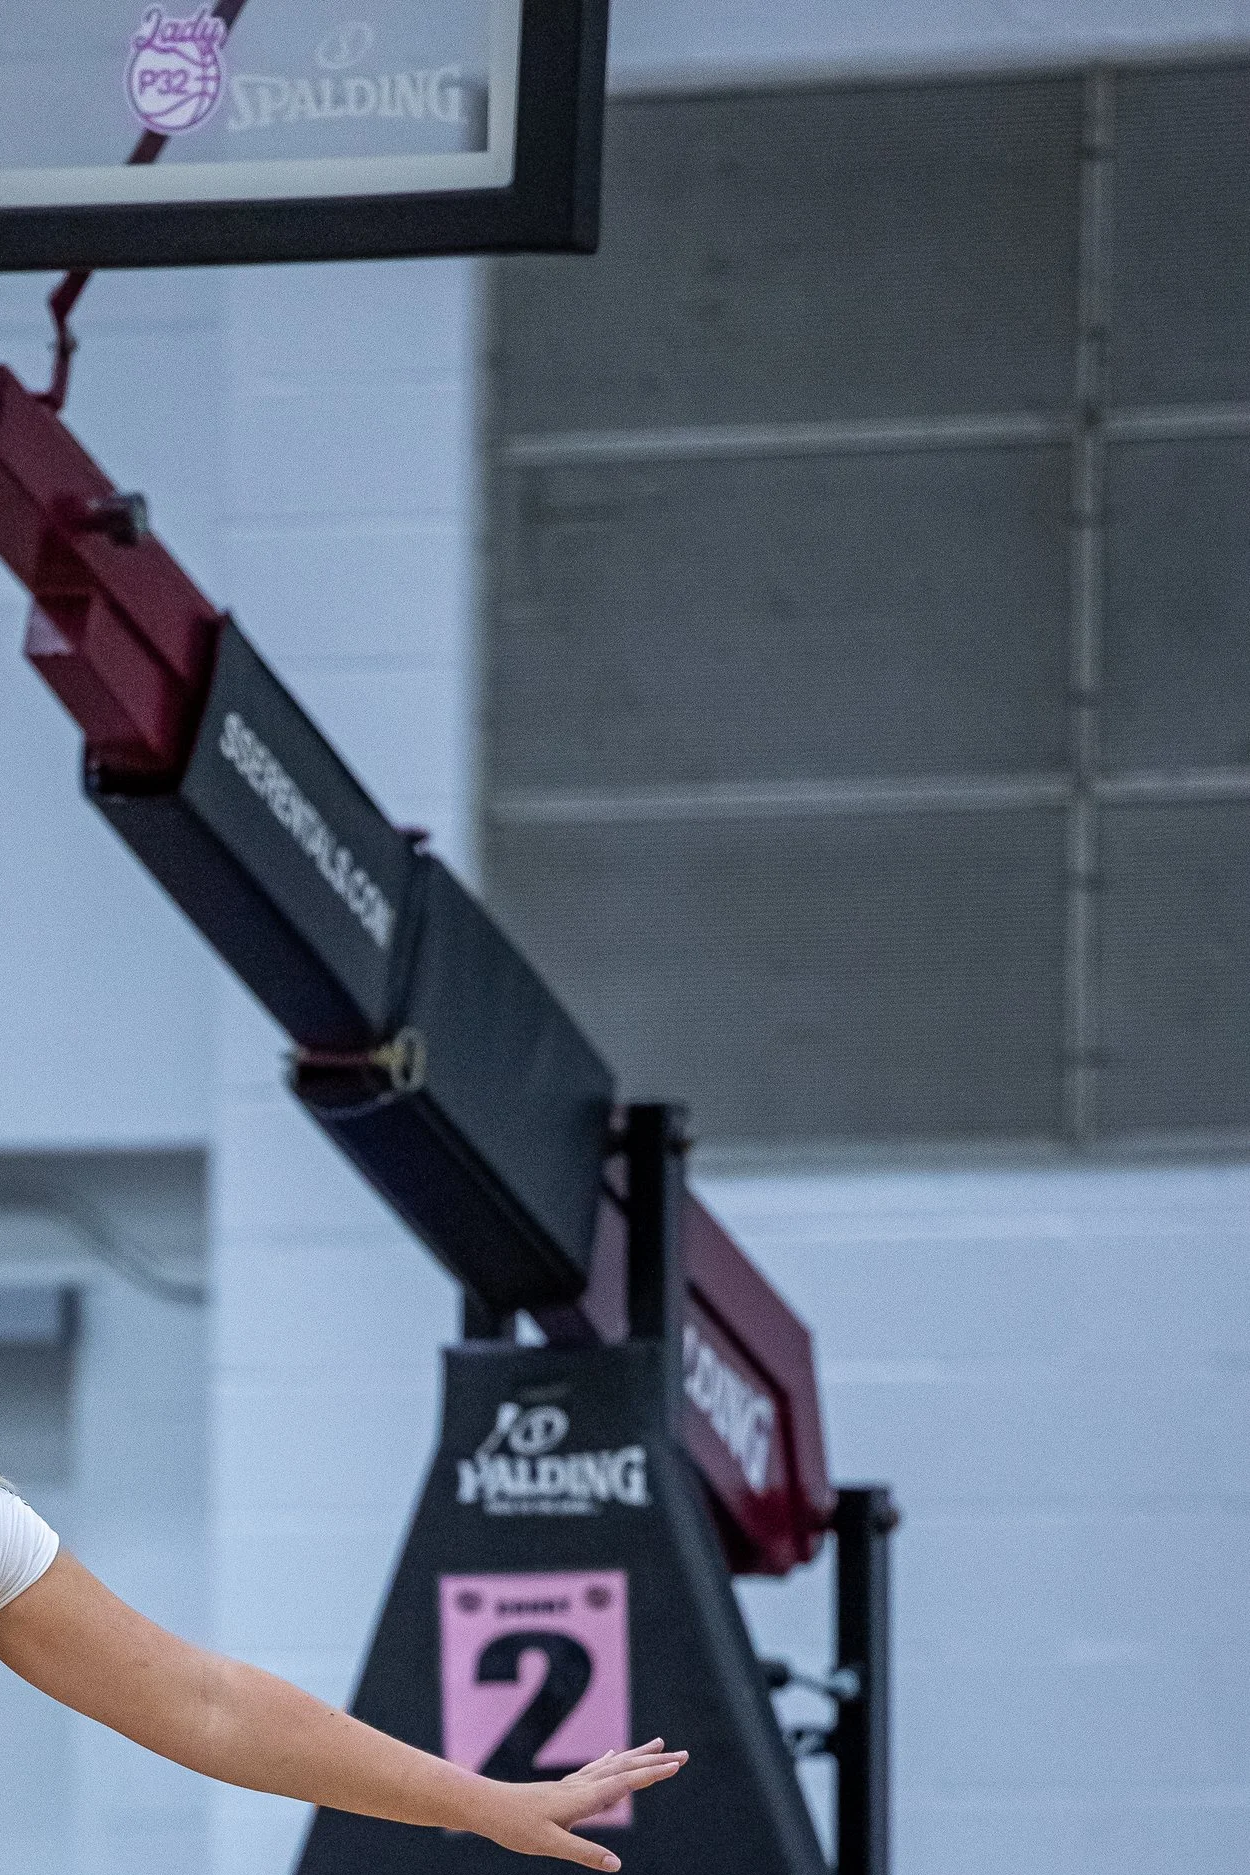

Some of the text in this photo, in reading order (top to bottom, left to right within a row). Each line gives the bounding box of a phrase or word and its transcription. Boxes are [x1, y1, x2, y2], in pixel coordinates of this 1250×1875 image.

[135, 8, 221, 62] Lady
[139, 69, 190, 96] P32
[227, 63, 468, 131] SPALDING
[476, 1631, 592, 1784] 2
